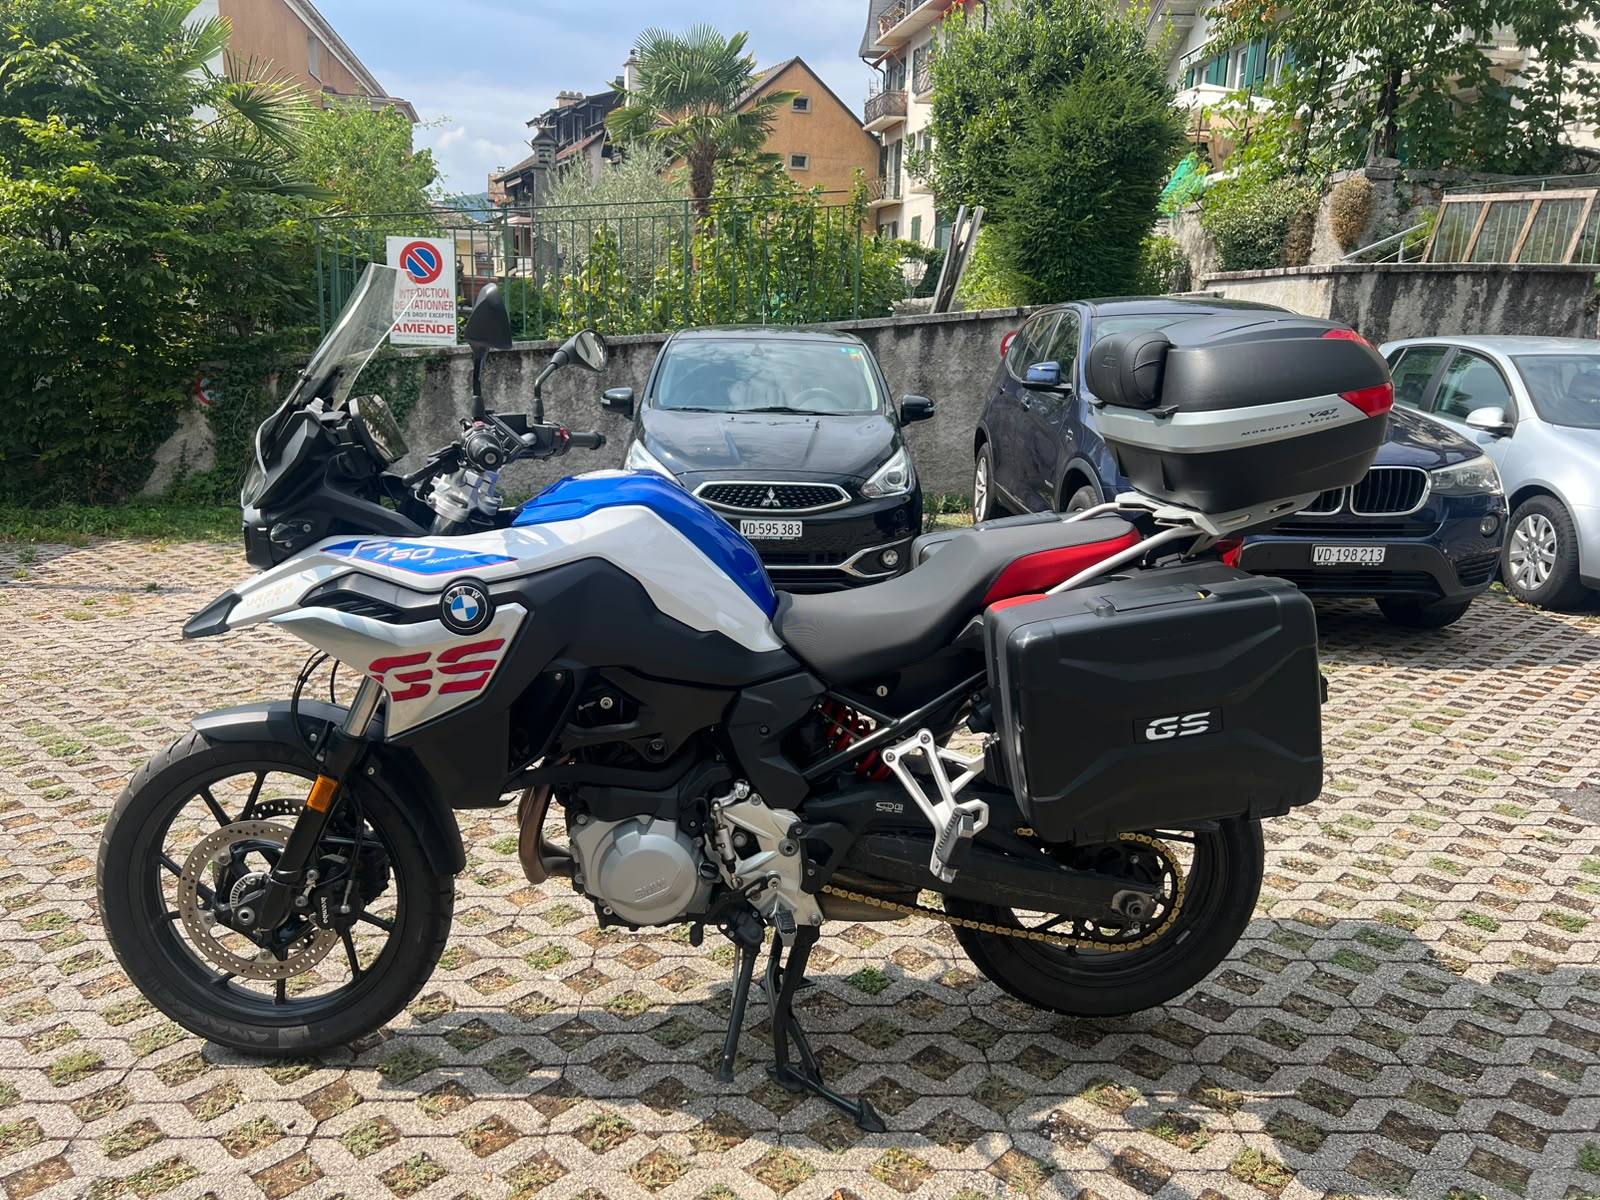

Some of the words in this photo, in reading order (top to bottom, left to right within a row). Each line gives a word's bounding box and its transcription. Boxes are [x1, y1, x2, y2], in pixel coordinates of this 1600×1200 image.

[407, 300, 454, 311] TATIONNER
[392, 323, 455, 334] AMENDE
[1309, 408, 1338, 418] V47
[1240, 423, 1297, 436] MONOKEY
[1301, 414, 1340, 425] SYSTEM
[445, 587, 482, 605] BMW
[369, 638, 506, 702] GS
[1145, 711, 1211, 741] GS
[634, 877, 669, 899] BMW
[320, 896, 330, 924] brembo
